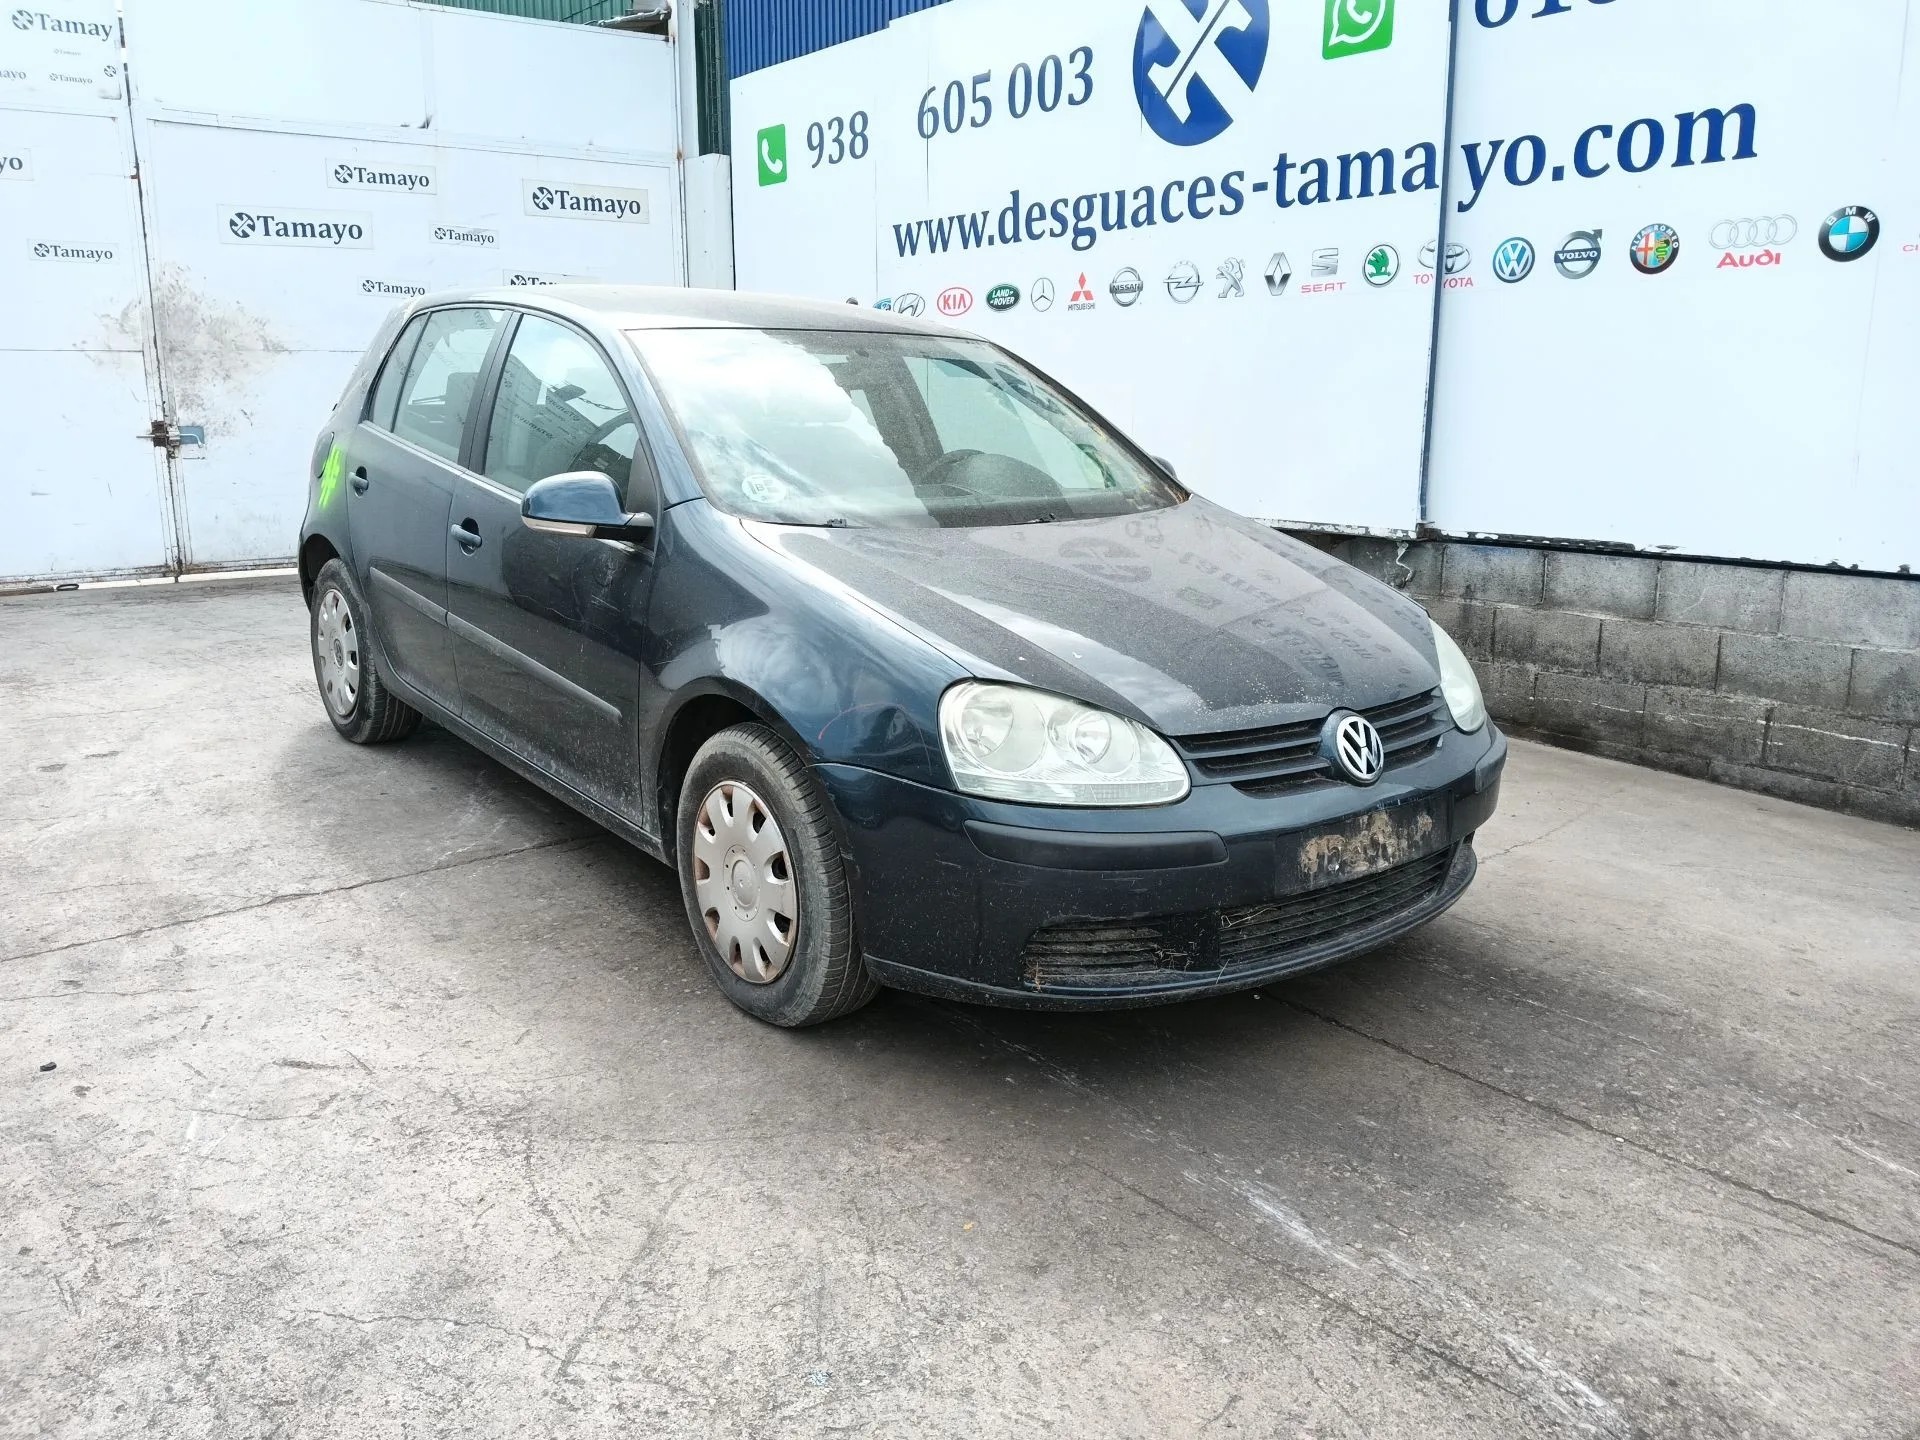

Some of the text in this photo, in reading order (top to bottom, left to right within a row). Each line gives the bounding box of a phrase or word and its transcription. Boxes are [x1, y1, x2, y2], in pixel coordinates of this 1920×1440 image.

[59, 74, 93, 84] Tamayo
[807, 45, 1094, 168] 938 605 003
[353, 166, 430, 190] Tamayo
[892, 102, 1758, 258] www.desguaces-tamayo.com
[554, 189, 641, 219] Tamayo
[1826, 206, 1876, 226] BMW
[256, 215, 363, 245] Tamayo
[447, 228, 495, 245] Tamayo
[50, 244, 113, 261] Tamayo
[1557, 249, 1598, 260] VOLVO
[1715, 249, 1782, 269] Audi
[374, 281, 426, 297] Tamayo
[992, 288, 1010, 298] LAND
[1112, 283, 1140, 292] NISSAN
[1301, 281, 1347, 294] SEAT
[943, 294, 967, 311] KIA
[993, 296, 1015, 306] ROVER
[1067, 302, 1096, 312] MITSUBISHI
